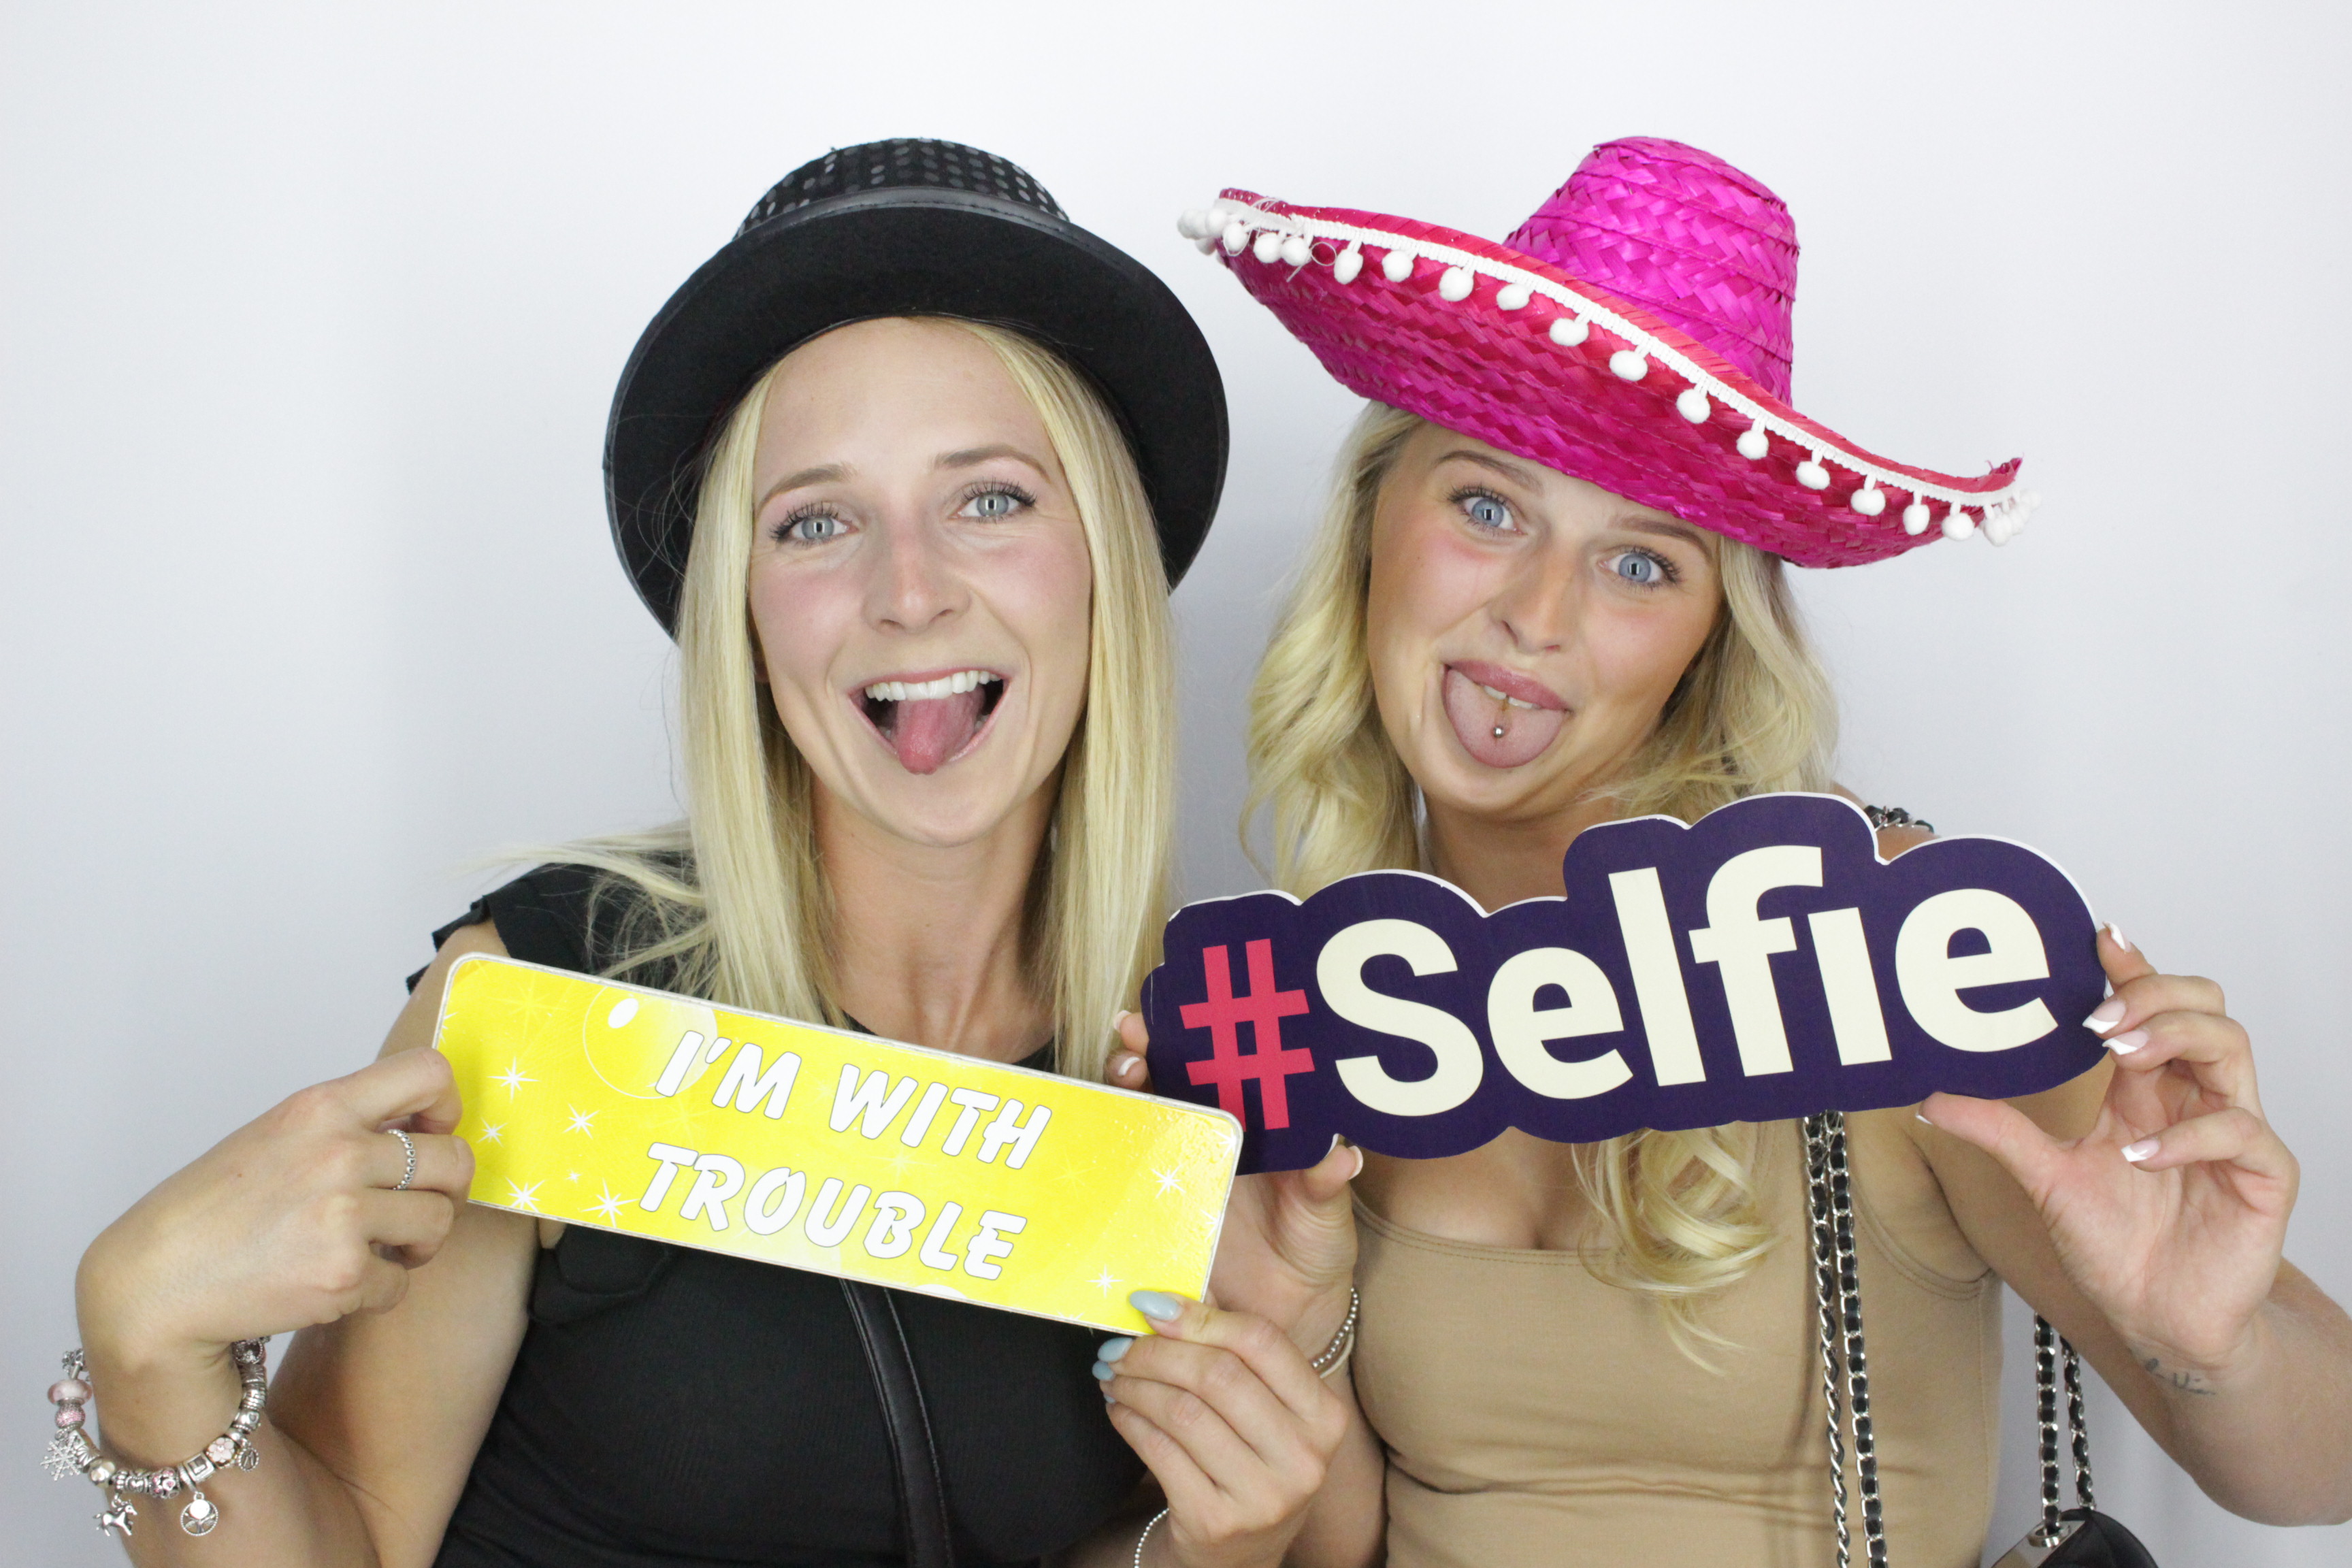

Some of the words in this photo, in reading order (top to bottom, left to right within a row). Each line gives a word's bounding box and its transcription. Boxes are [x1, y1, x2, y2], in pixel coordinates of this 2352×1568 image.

[1179, 845, 2059, 1130] #Selfie
[654, 1030, 802, 1120] I'M
[828, 1062, 1053, 1170] WITH
[638, 1141, 1028, 1281] TROUBLE
